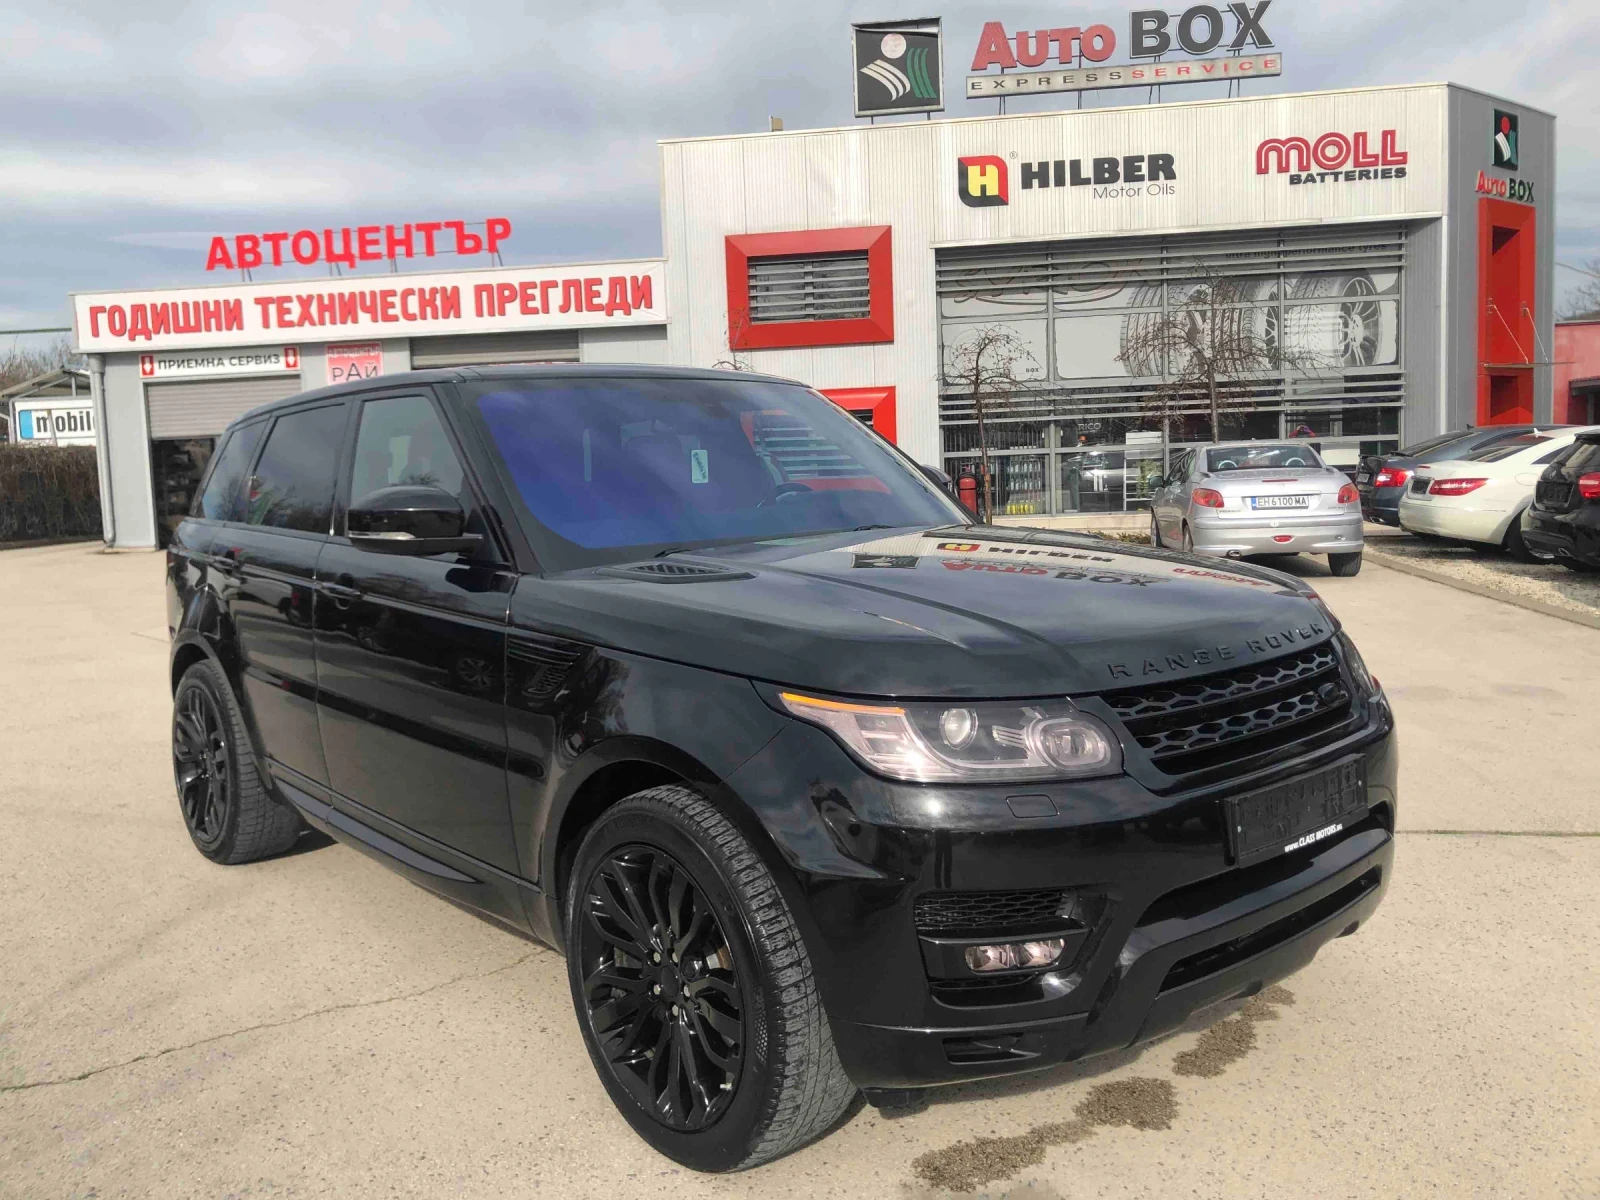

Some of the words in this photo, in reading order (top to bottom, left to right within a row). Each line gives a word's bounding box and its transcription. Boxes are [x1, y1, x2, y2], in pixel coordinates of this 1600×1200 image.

[1129, 0, 1276, 58] BOX
[1021, 153, 1177, 190] HILBER
[1289, 167, 1408, 185] BATTERIES
[1093, 185, 1142, 200] Motor
[1147, 183, 1176, 196] Oils
[1507, 177, 1535, 203] BOX
[205, 217, 512, 272] АВТОЦЕНТЪР
[89, 298, 244, 342] ГОДИШНИ
[254, 285, 461, 329] ТЕХНИЧЕСКИ
[474, 275, 653, 317] ПРЕГЛЕДИ
[158, 358, 226, 370] ПРИЕМНА
[229, 353, 281, 367] СЕРВИЗ
[331, 361, 379, 382] РАЙ
[36, 410, 96, 433] mobil
[1107, 644, 1235, 680] RANGE
[1245, 621, 1325, 655] ROVER
